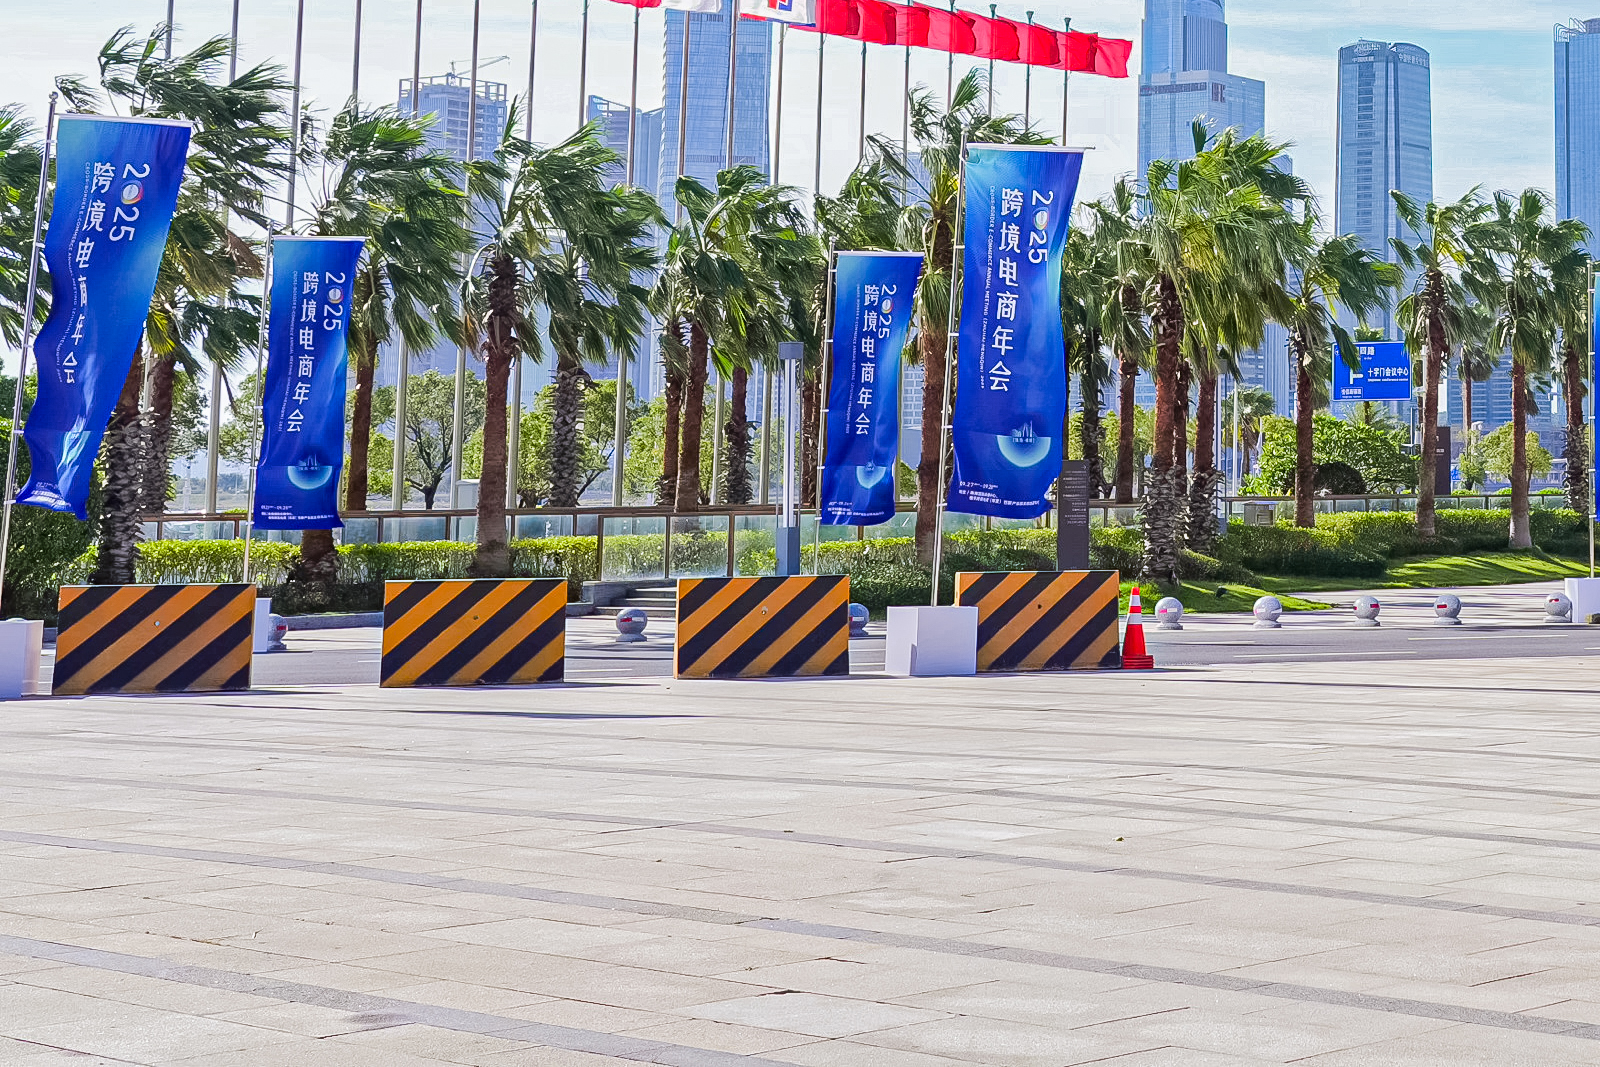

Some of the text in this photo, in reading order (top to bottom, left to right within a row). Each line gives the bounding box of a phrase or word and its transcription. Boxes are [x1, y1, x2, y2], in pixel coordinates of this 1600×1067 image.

[109, 163, 150, 241] 2025
[1028, 190, 1054, 264] 2025
[323, 272, 346, 331] 2025
[878, 284, 897, 338] 2025
[988, 187, 1024, 392] 跨境电商年会
[287, 271, 320, 432] 跨境电商年会
[855, 284, 880, 435] 跨境电商年会
